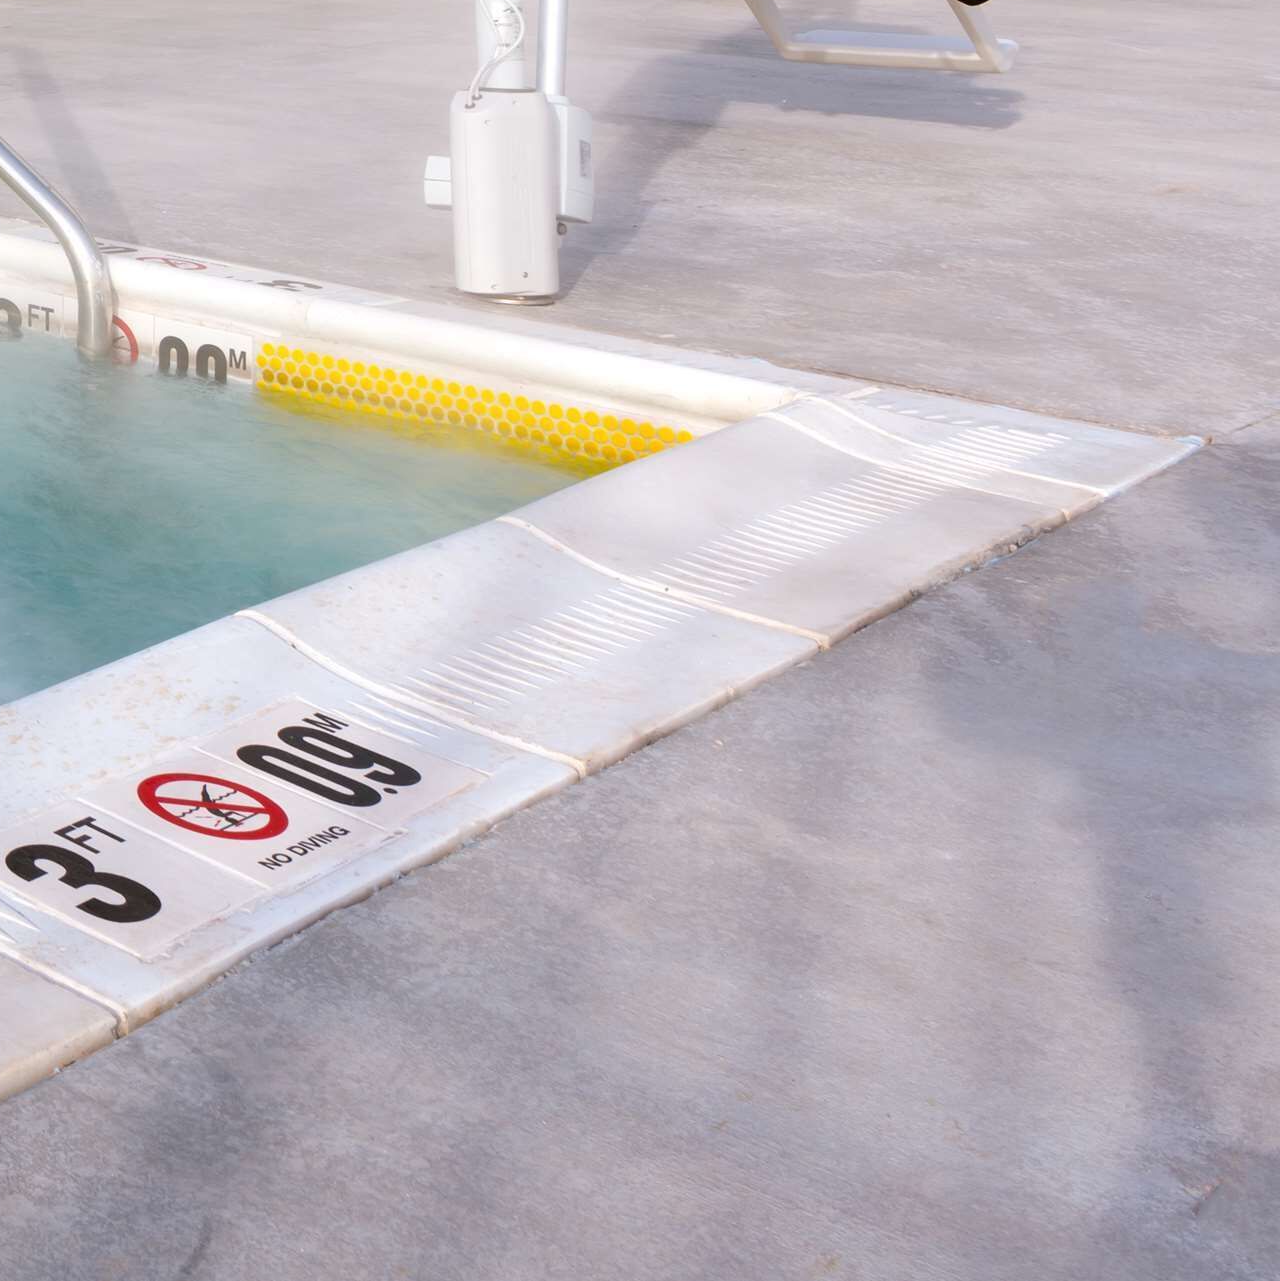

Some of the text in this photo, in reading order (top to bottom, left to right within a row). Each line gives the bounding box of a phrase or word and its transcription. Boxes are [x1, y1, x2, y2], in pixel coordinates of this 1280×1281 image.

[27, 303, 56, 332] FT
[228, 347, 247, 371] M
[302, 712, 349, 734] M
[53, 816, 126, 854] FT
[258, 825, 351, 871] NO DIVING
[5, 844, 162, 923] 3
